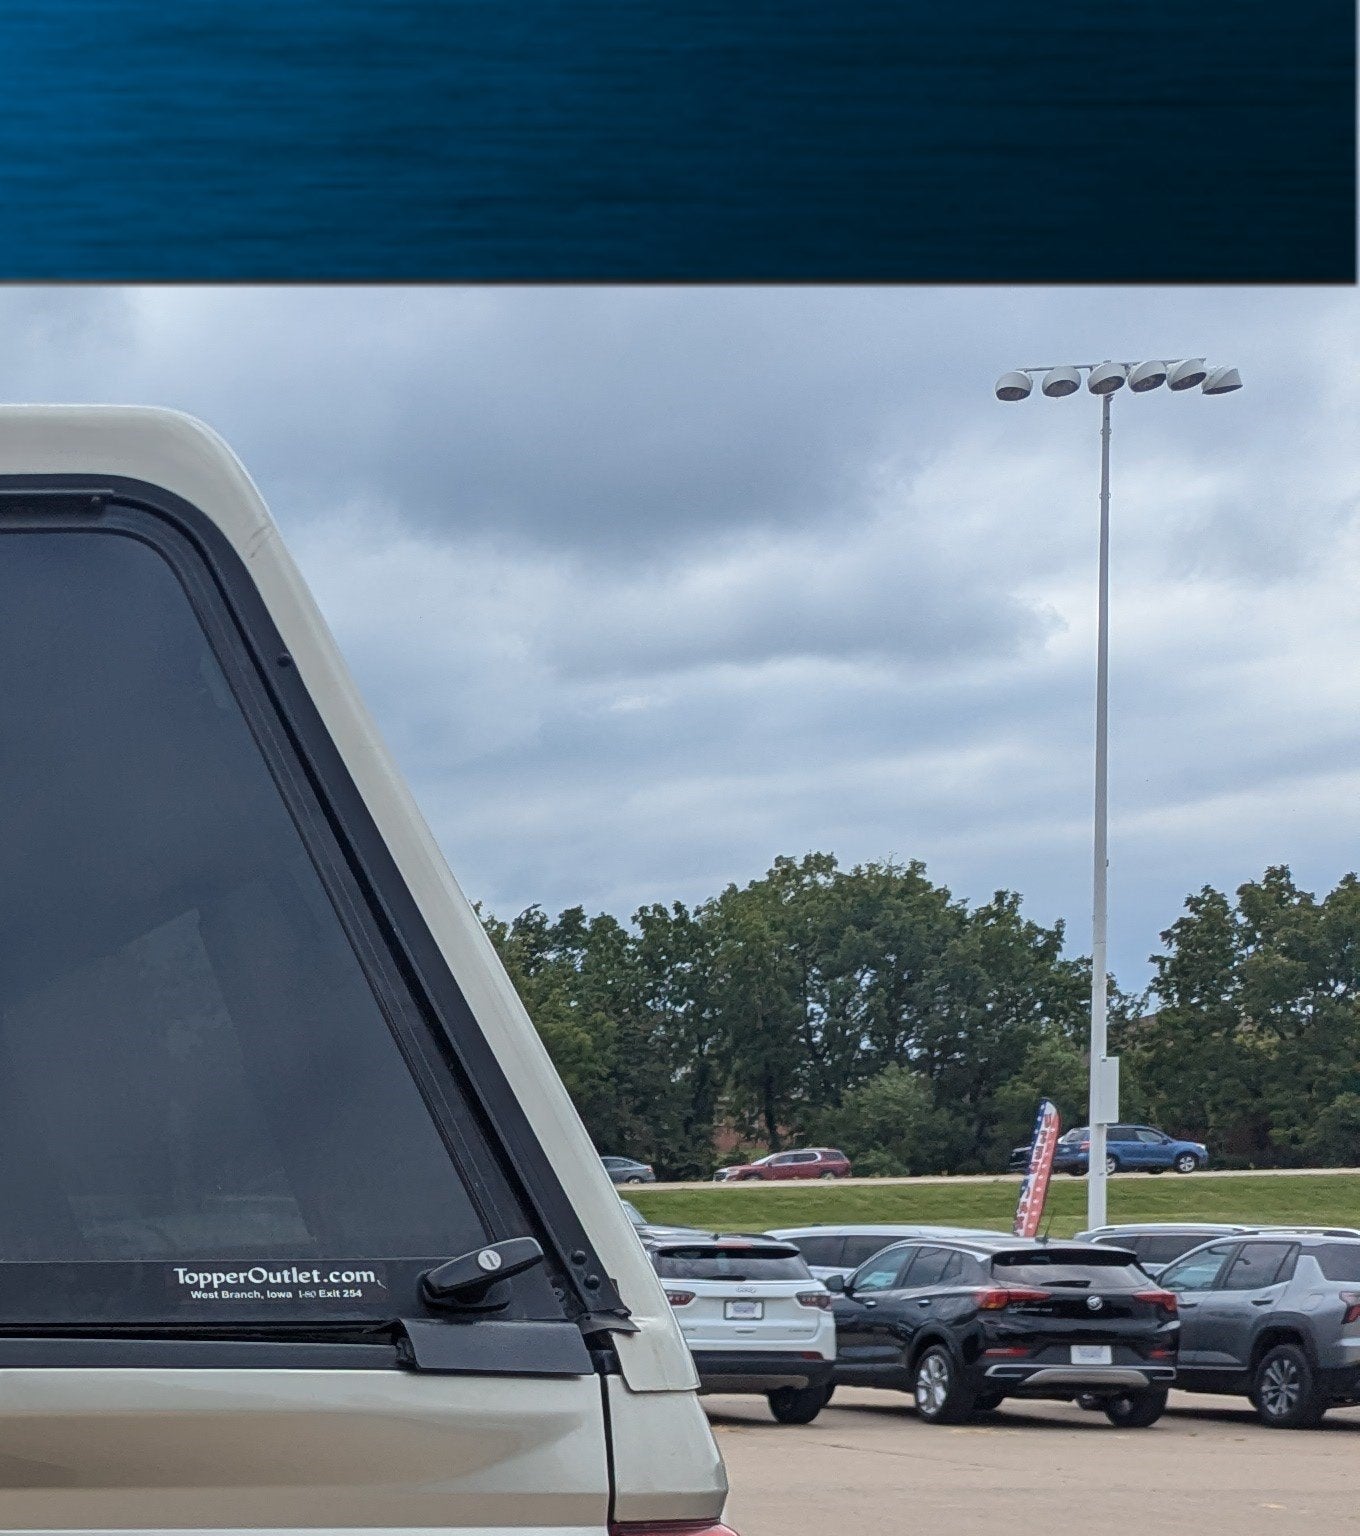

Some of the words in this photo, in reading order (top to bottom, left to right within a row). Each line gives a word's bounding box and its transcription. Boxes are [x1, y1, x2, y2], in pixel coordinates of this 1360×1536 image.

[173, 1266, 376, 1288] TopperOutlet.com
[190, 1289, 219, 1300] West
[221, 1289, 265, 1300] Branch,
[267, 1289, 293, 1299] Iowa
[319, 1288, 341, 1299] Exit
